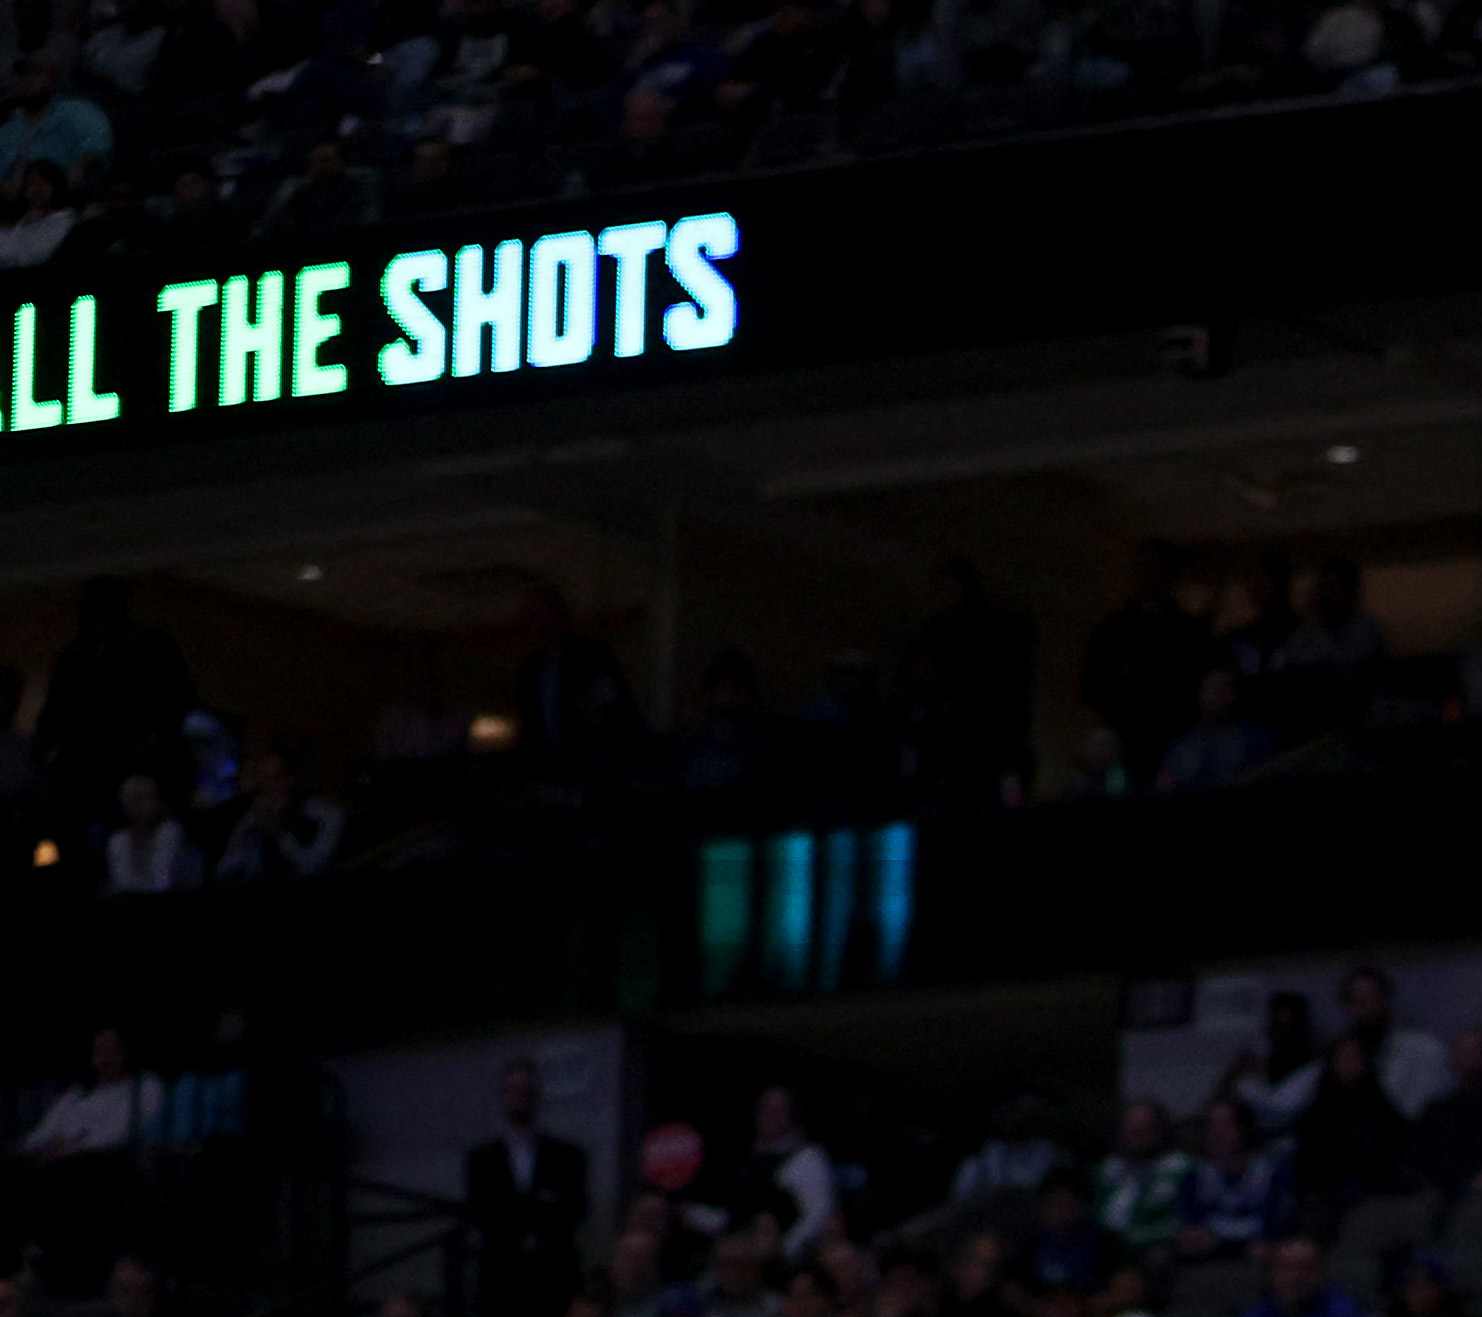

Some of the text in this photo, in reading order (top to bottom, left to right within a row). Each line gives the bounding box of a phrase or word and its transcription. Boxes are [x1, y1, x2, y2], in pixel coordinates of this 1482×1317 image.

[0, 211, 740, 433] LL THE SHOTS
